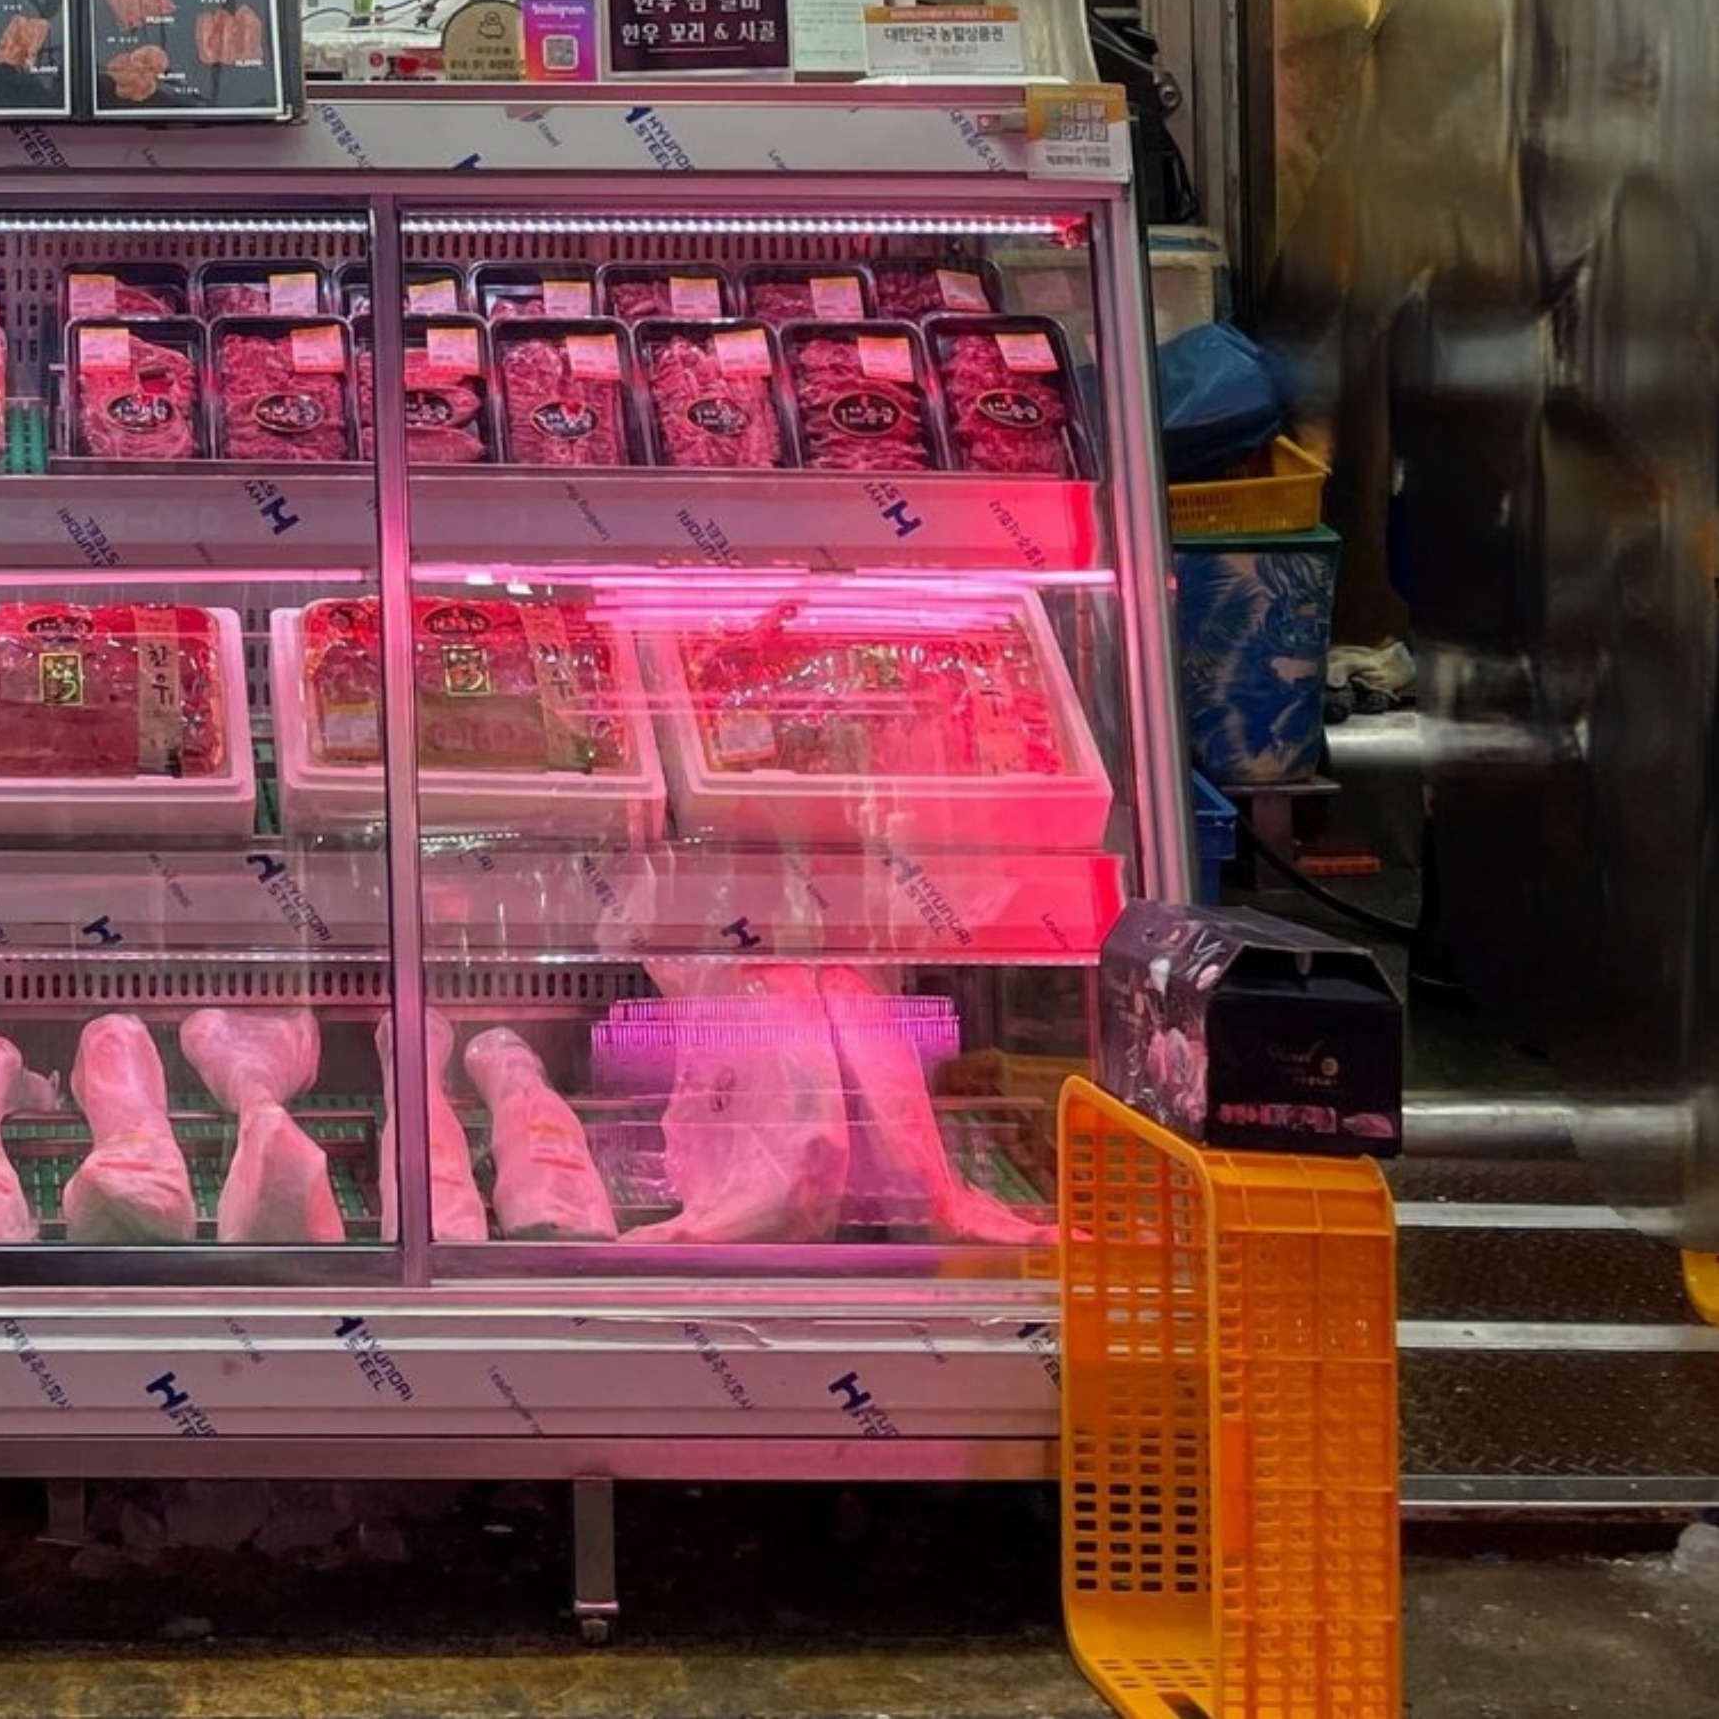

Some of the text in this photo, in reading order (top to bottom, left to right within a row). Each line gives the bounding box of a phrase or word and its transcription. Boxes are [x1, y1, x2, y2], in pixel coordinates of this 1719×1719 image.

[531, 1, 587, 19] Instagram
[621, 20, 776, 47] 한우 꼬리 & 사골
[882, 26, 938, 43] 대한민국
[265, 883, 306, 935] STEEL
[279, 873, 334, 942] HYUNDAI
[904, 883, 945, 937] STEEL
[915, 873, 974, 947] HYUNDAI
[343, 1335, 384, 1393] STEEL
[356, 1324, 415, 1403] HYUNDAI
